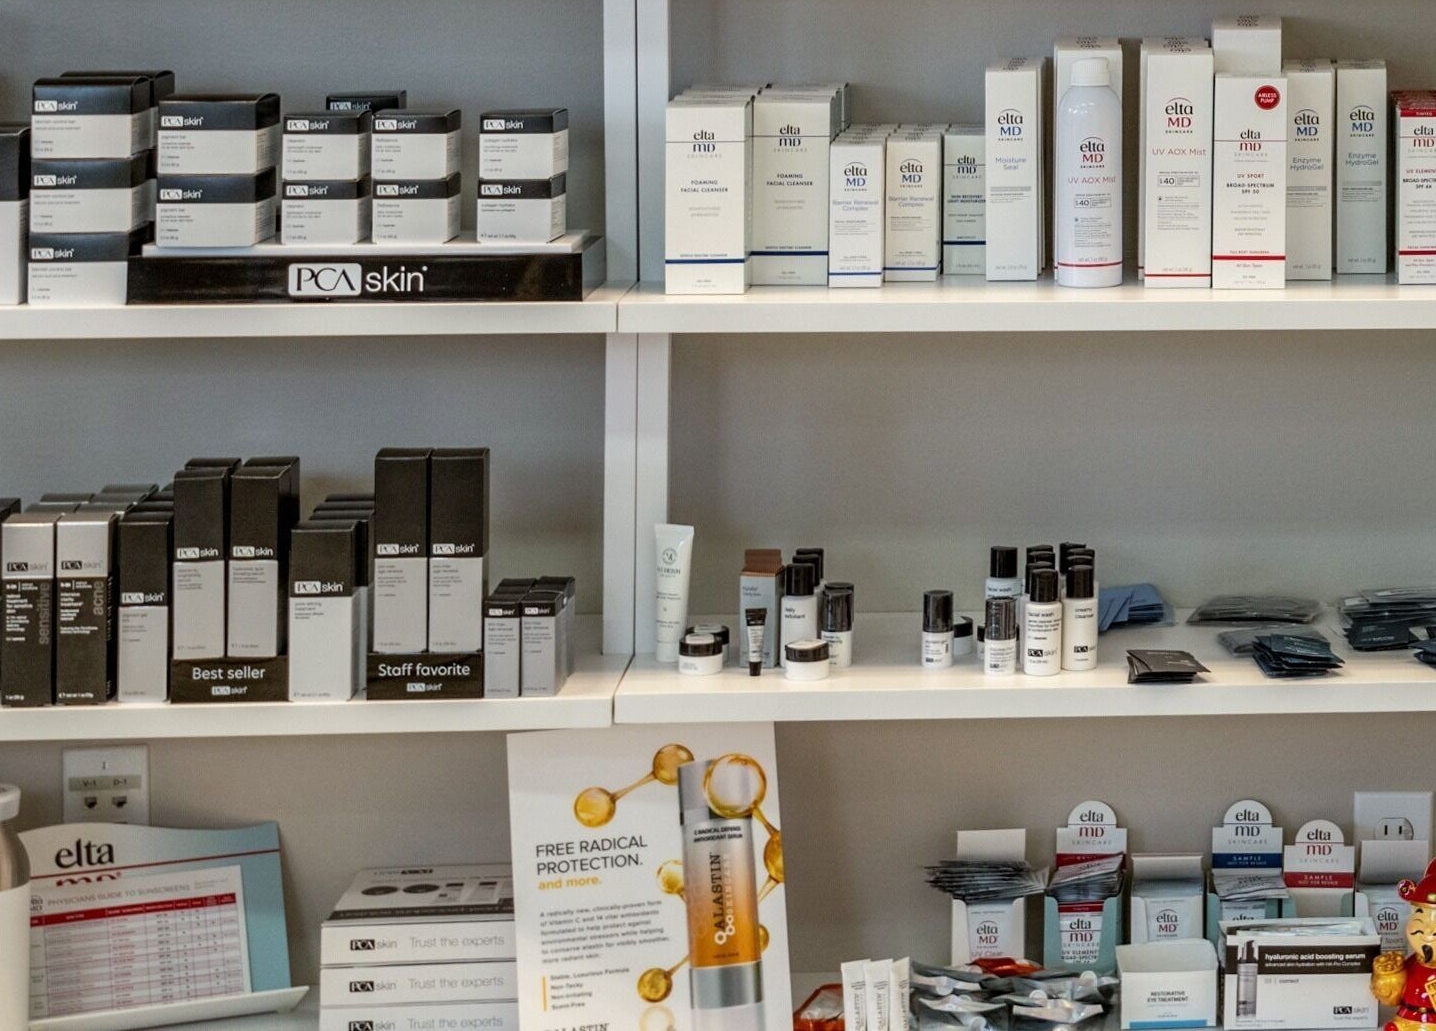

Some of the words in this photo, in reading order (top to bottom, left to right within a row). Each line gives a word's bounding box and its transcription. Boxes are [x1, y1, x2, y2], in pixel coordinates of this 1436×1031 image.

[1165, 102, 1193, 115] elta
[1168, 117, 1192, 128] MD
[1348, 152, 1376, 160] Enzyme
[297, 268, 355, 291] PCA
[93, 582, 104, 615] acne
[39, 584, 50, 644] sensitive
[192, 667, 223, 680] Best
[227, 666, 265, 679] seller
[378, 663, 413, 676] Staff
[416, 663, 470, 676] favorite
[536, 842, 574, 857] FREE
[580, 836, 647, 853] RADICAL
[55, 839, 114, 869] elta
[537, 854, 643, 875] PROTECTION.
[538, 878, 563, 890] and
[566, 877, 601, 887] more.
[411, 937, 436, 947] Trust
[440, 937, 459, 946] the
[462, 935, 505, 948] experts
[1265, 953, 1298, 962] hyaluronic
[1316, 953, 1343, 961] boosting
